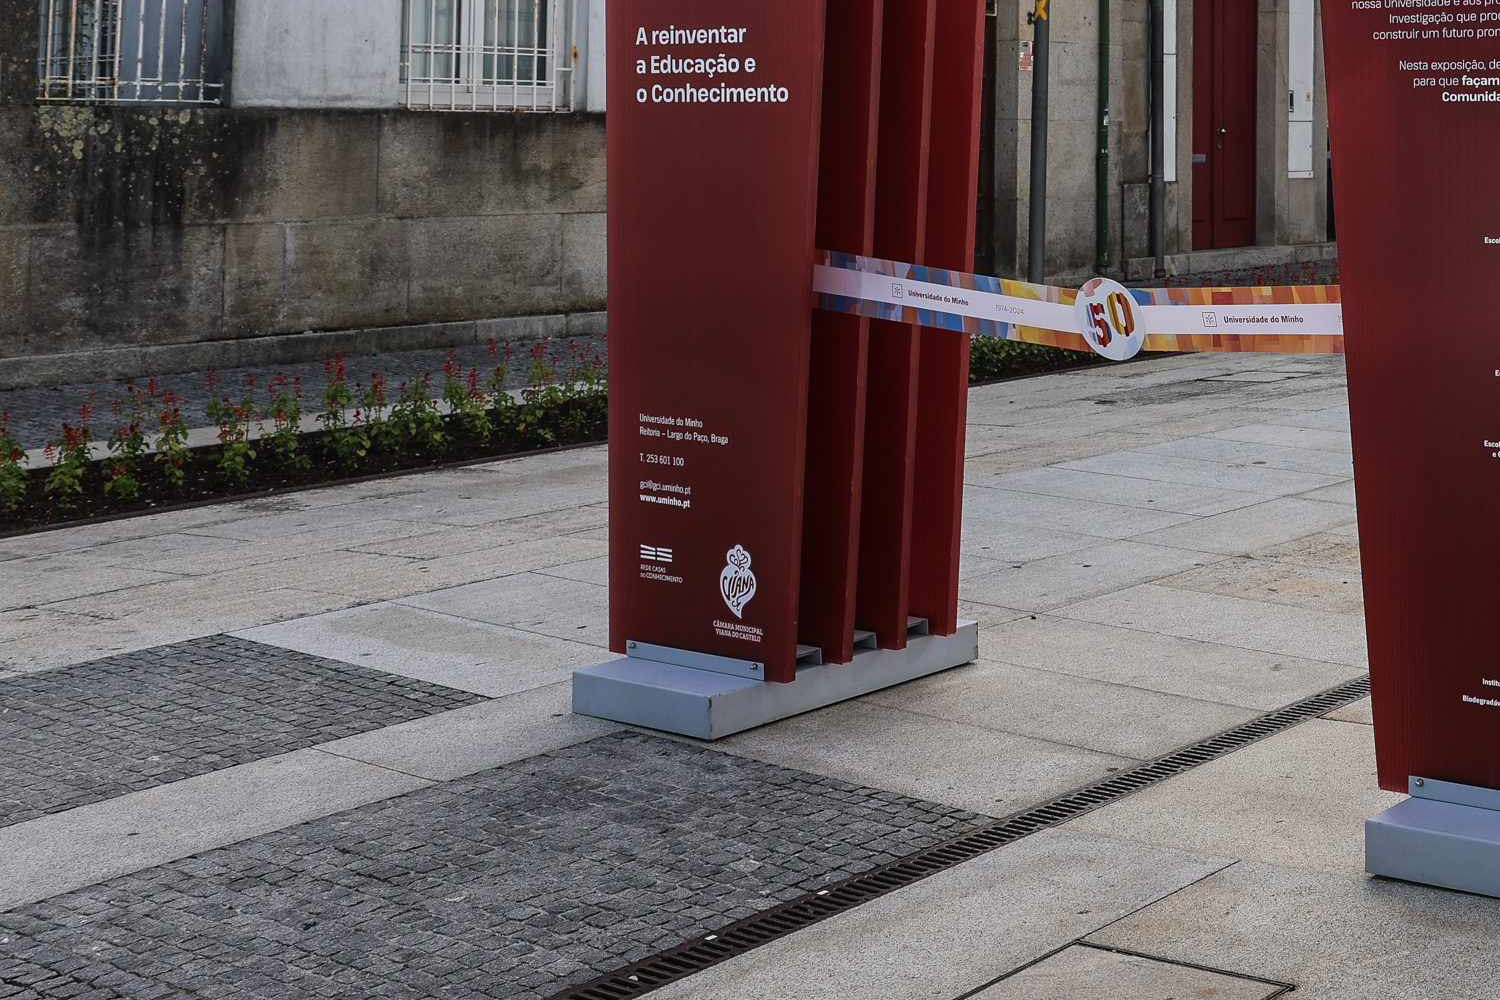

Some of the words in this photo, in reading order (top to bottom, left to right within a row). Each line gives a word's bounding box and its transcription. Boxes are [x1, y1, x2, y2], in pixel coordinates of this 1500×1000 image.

[1352, 1, 1381, 9] nossa
[1390, 12, 1453, 25] Investigação
[1457, 13, 1476, 23] que
[636, 27, 648, 45] A
[652, 25, 746, 44] reinventar
[1373, 29, 1419, 39] construir
[1442, 27, 1473, 38] futuro
[637, 60, 646, 74] a
[651, 54, 739, 78] Educação
[745, 58, 755, 72] e
[1400, 61, 1428, 70] Nesta
[1431, 60, 1486, 72] exposição,
[1414, 78, 1435, 88] para
[1439, 78, 1459, 88] que
[1462, 75, 1499, 88] façam
[637, 88, 647, 102] o
[652, 83, 788, 102] Conhecimento
[908, 289, 942, 302] Universidade
[944, 295, 950, 303] do
[952, 298, 969, 306] Minho
[995, 304, 1024, 315] 1974-2024
[1086, 291, 1135, 347] 50
[1224, 316, 1268, 324] Universidade
[640, 413, 675, 425] Universidade
[676, 418, 683, 426] do
[685, 418, 703, 428] Minho
[640, 426, 660, 436] Reitoria
[667, 430, 683, 440] Largo
[684, 432, 692, 440] do
[694, 432, 709, 443] Paço,
[711, 434, 728, 445] Braga
[640, 453, 645, 461] T.
[647, 454, 658, 463] 253
[659, 455, 670, 465] 601
[673, 457, 684, 466] 100
[640, 494, 690, 509] www.uminho.pt
[716, 628, 731, 637] VIANA
[739, 633, 761, 642] CASTELO
[735, 625, 763, 635] MUNICIPAL
